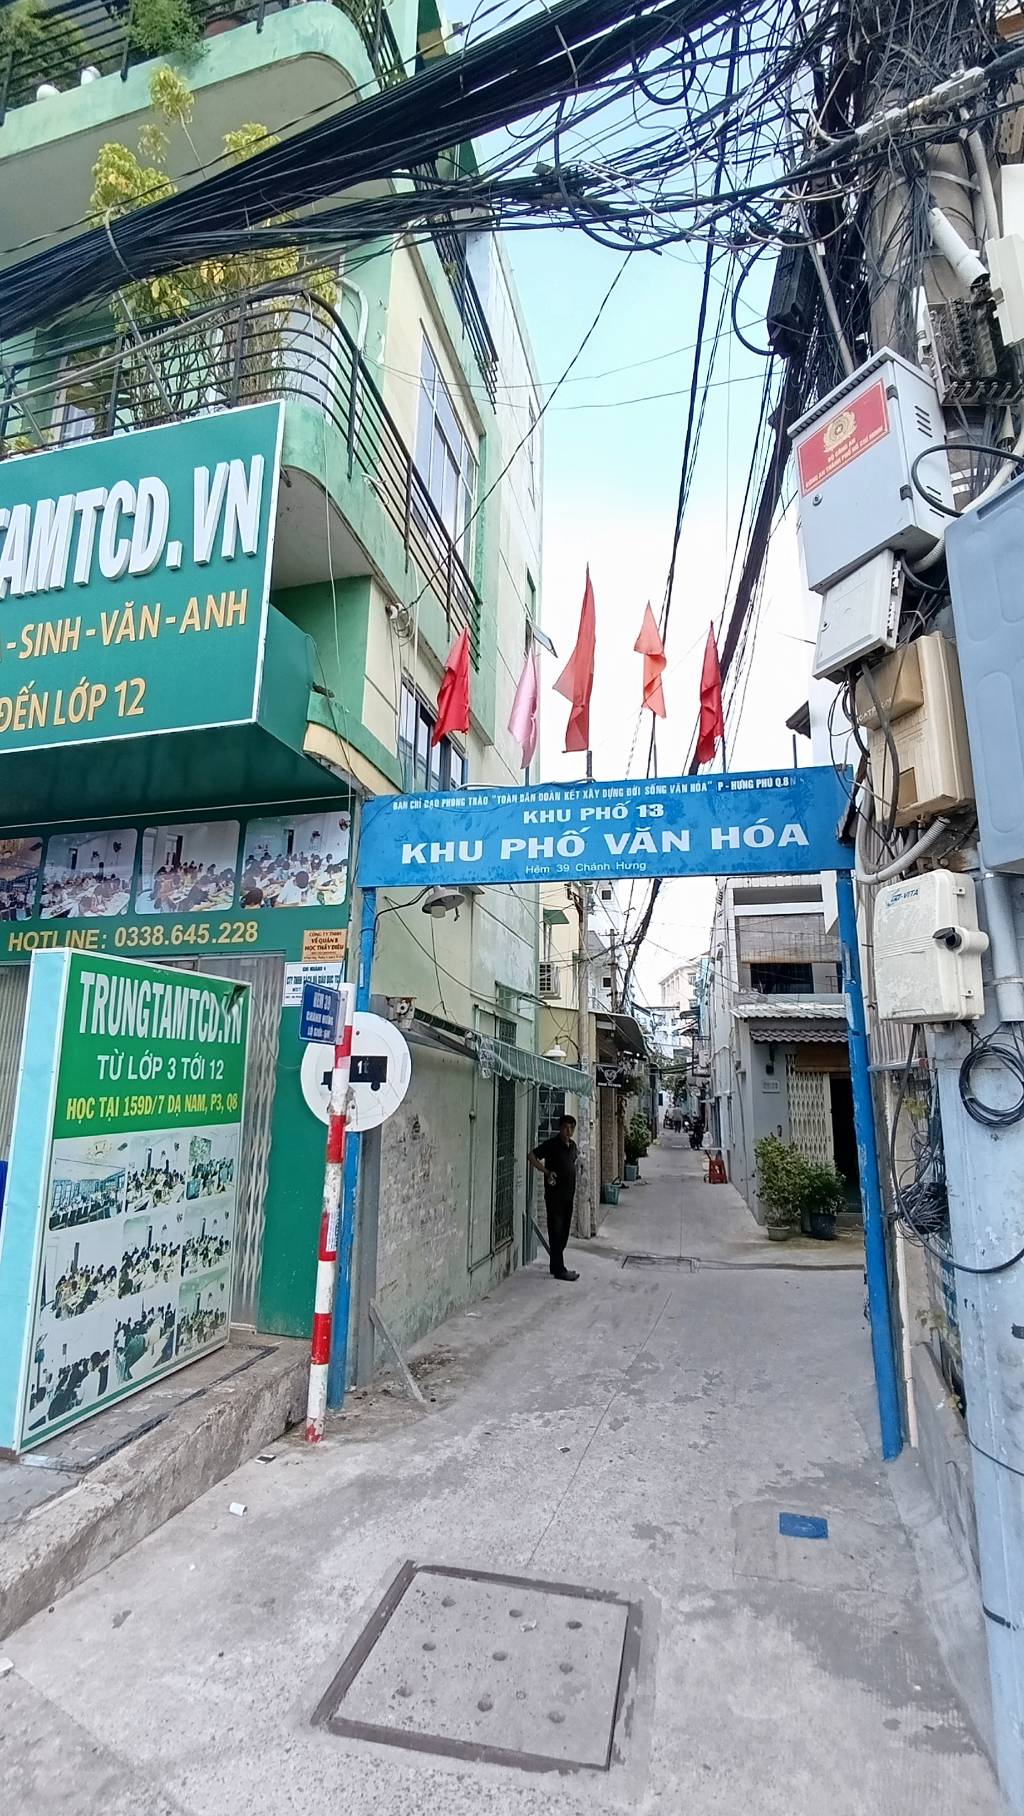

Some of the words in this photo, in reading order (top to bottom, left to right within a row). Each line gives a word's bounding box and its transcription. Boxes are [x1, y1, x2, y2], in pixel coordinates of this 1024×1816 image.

[0, 455, 265, 598] AMTCD.VN
[53, 676, 107, 726] LỚP
[115, 677, 146, 717] 12
[392, 801, 408, 810] BAN
[442, 798, 466, 808] PHONG
[582, 788, 600, 799] XÂY
[644, 782, 666, 795] SỐNG
[670, 781, 688, 793] VĂN
[731, 779, 754, 790] HƯNG
[775, 776, 789, 787] Q.8
[523, 808, 571, 824] KHU
[580, 800, 629, 820] PHỐ
[636, 803, 664, 818] 13
[402, 840, 483, 864] KHU
[500, 826, 591, 860] PHỐ
[604, 827, 690, 854] VĂN
[711, 818, 809, 850] HÓA
[556, 864, 570, 872] 39
[576, 862, 610, 872] Chánh
[616, 862, 646, 872] Hưng
[114, 921, 258, 947] 0338.645.228
[79, 971, 243, 1044] TRUNGTAMTCD.VN
[98, 1049, 124, 1080] TỪ
[128, 1050, 162, 1080] LỚP
[168, 1058, 176, 1080] 3
[182, 1052, 204, 1080] TỚI
[210, 1060, 224, 1080] 12
[66, 1097, 95, 1124] HỌC
[99, 1096, 120, 1122] TẠI
[123, 1095, 165, 1117] 159D/7
[168, 1095, 181, 1117] DẠ
[184, 1094, 208, 1114] NAM,
[210, 1094, 224, 1114] P3,
[227, 1092, 238, 1112] Q8
